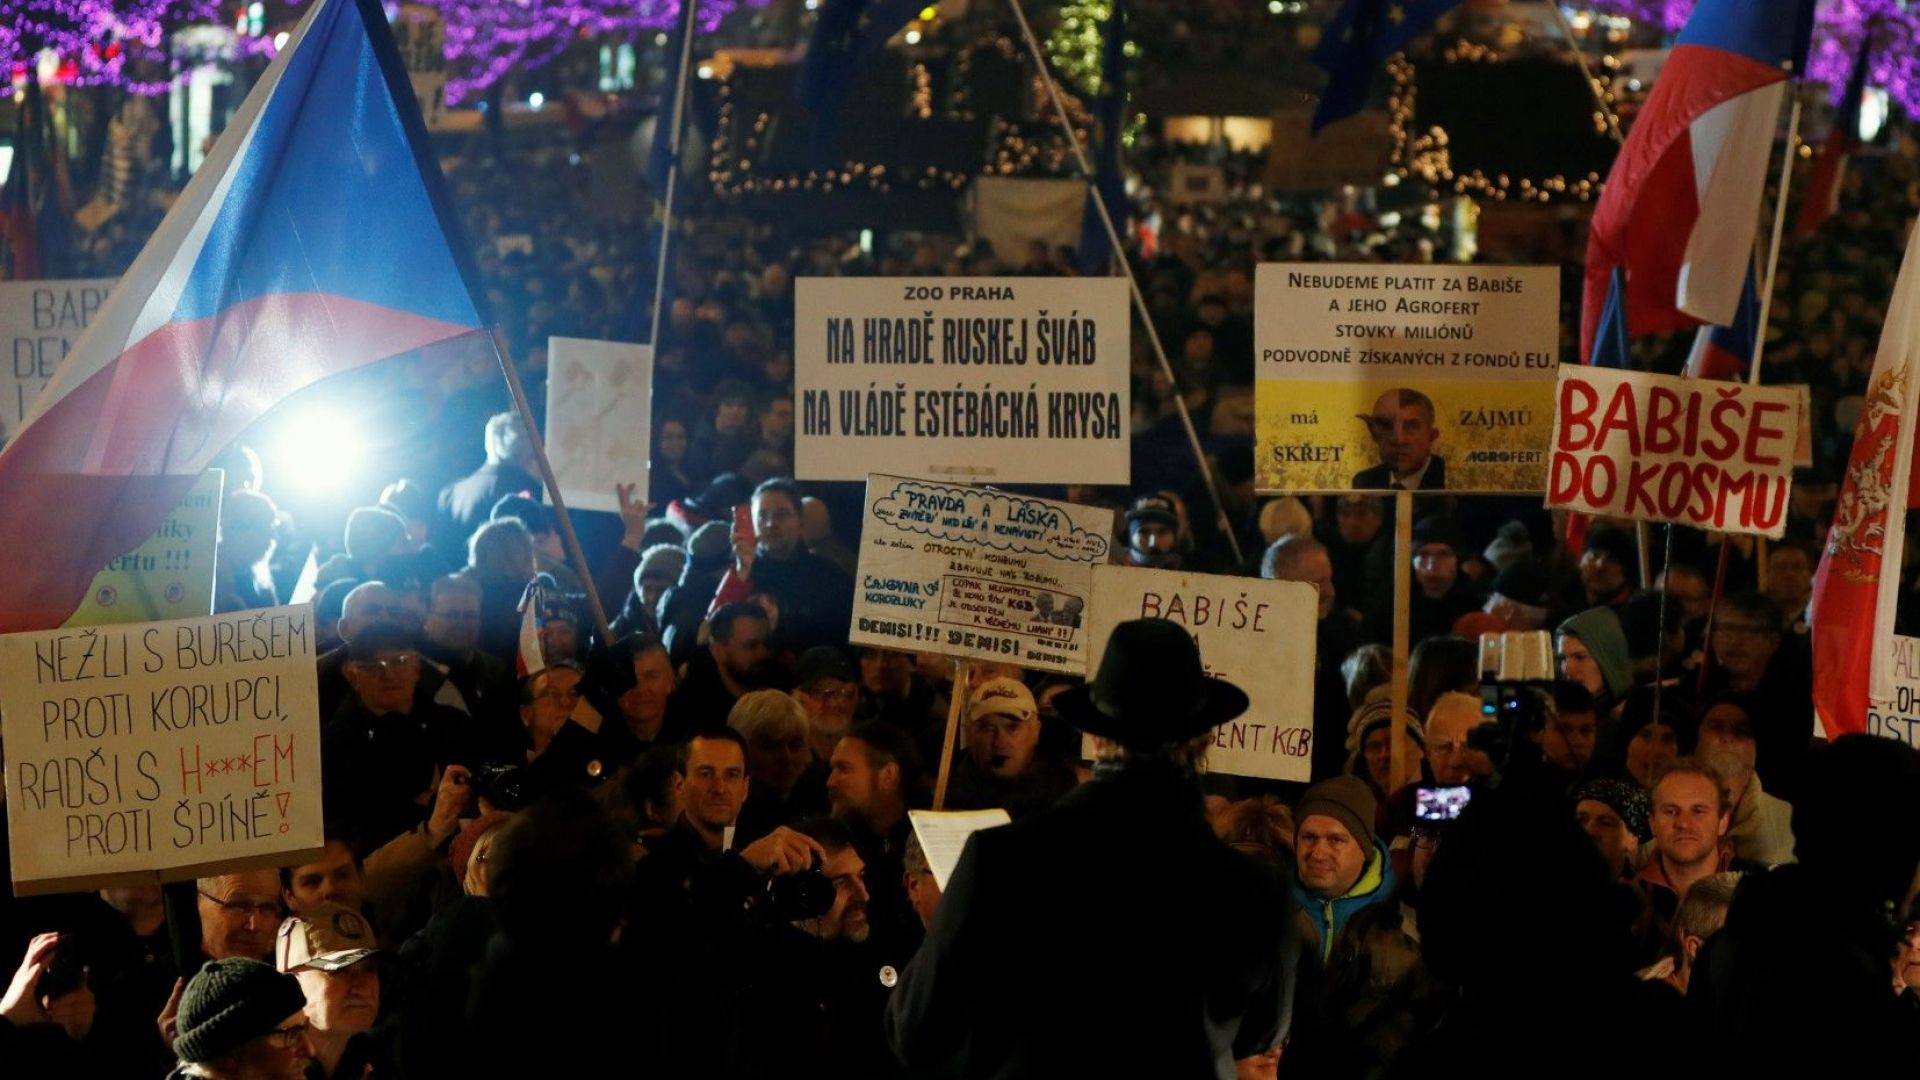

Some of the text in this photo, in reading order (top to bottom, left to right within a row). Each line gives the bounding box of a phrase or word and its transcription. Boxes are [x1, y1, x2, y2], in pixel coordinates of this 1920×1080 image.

[903, 286, 1015, 301] ZOO PRAHA
[1384, 276, 1436, 291] PLATIT
[1442, 277, 1462, 292] ZA
[1467, 276, 1523, 294] BABIŠE
[1328, 298, 1481, 315] A JEHO AGROFERT
[826, 309, 1097, 366] NA HRADĚ RUSKEJ ŠVÁB
[1335, 323, 1474, 341] STOVKY MILIÓNŮ
[1262, 346, 1352, 364] PODVODNĚ
[1358, 347, 1445, 366] ZÍSKANÝCH
[1451, 353, 1461, 366] Z
[1464, 351, 1521, 368] FONDŮ
[803, 382, 1121, 440] NA VLÁDĚ ESTÉBÁCKÁ KRYSA
[1290, 409, 1319, 425] má
[1458, 404, 1533, 429] ZÁJMŮ
[1557, 377, 1791, 467] BABIŠE
[1272, 442, 1345, 464] SKŘET
[1465, 450, 1542, 464] AGROFERT
[1549, 450, 1787, 530] DO KOSMU
[905, 489, 966, 514] PRAVDA
[981, 502, 991, 518] A
[1007, 502, 1060, 530] LÁSKA
[1141, 591, 1270, 633] BABIŠE
[35, 611, 309, 685] NEŽLI S BUREŠEM
[946, 630, 1020, 656] DEMISI
[42, 675, 289, 743] PROTI KORUPCI,
[1271, 724, 1313, 758] KGB
[18, 746, 124, 811] RADŠI
[136, 750, 162, 802] S
[65, 807, 153, 859] PROTI
